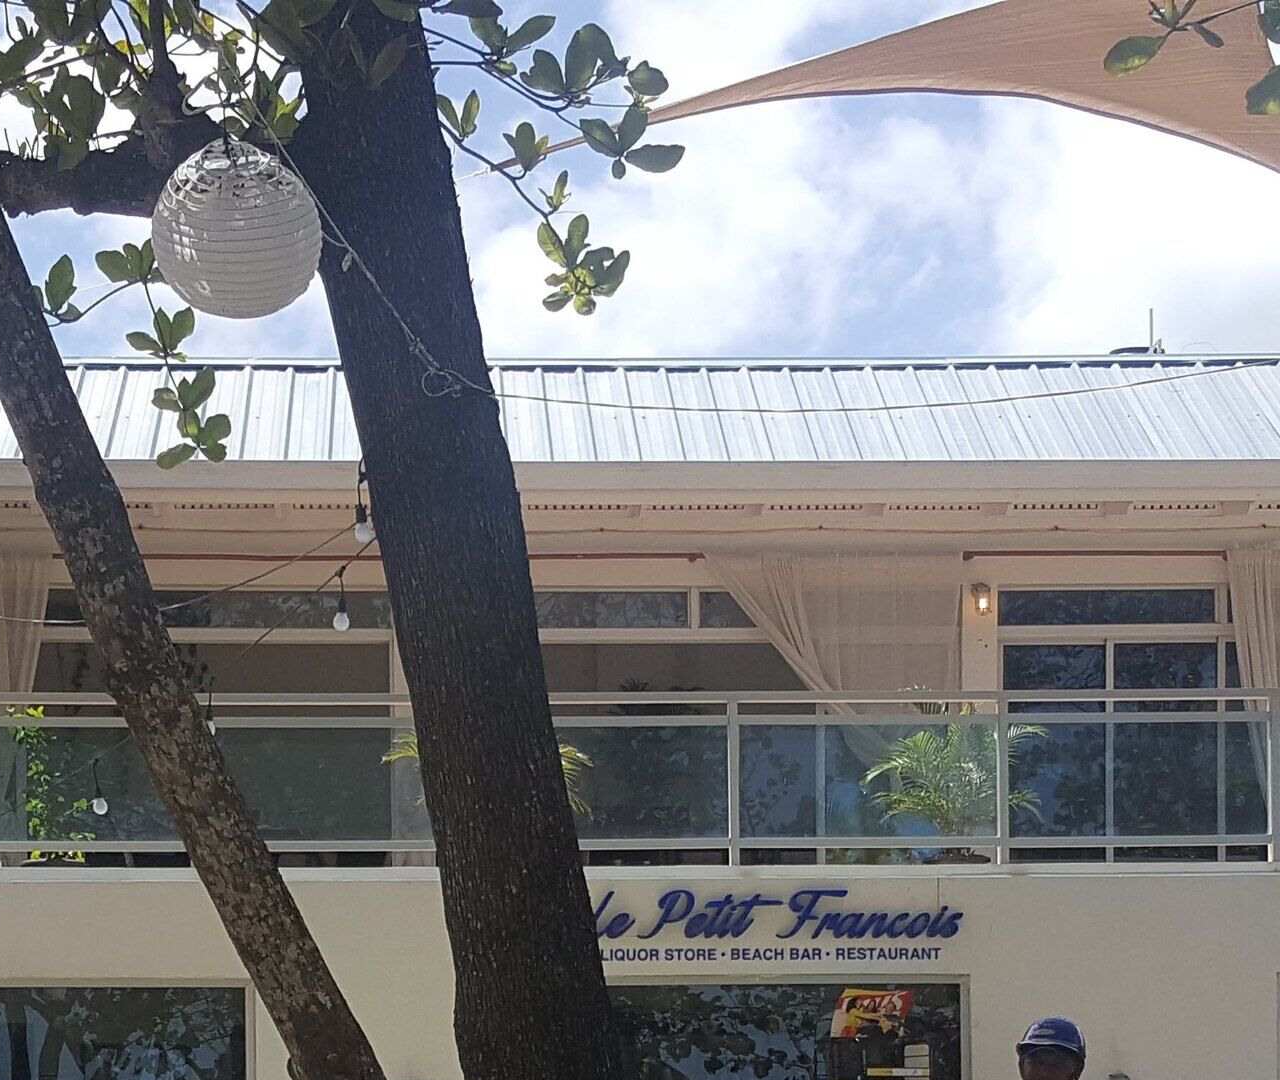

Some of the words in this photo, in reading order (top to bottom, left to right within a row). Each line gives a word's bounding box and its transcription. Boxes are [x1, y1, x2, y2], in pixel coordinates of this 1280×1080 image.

[637, 889, 784, 940] Petit
[776, 889, 964, 940] Francois
[601, 948, 660, 962] LIQUOR
[664, 948, 718, 962] STORE
[730, 948, 785, 961] BEACH
[789, 948, 822, 961] BAR
[835, 947, 942, 961] RESTAURANT
